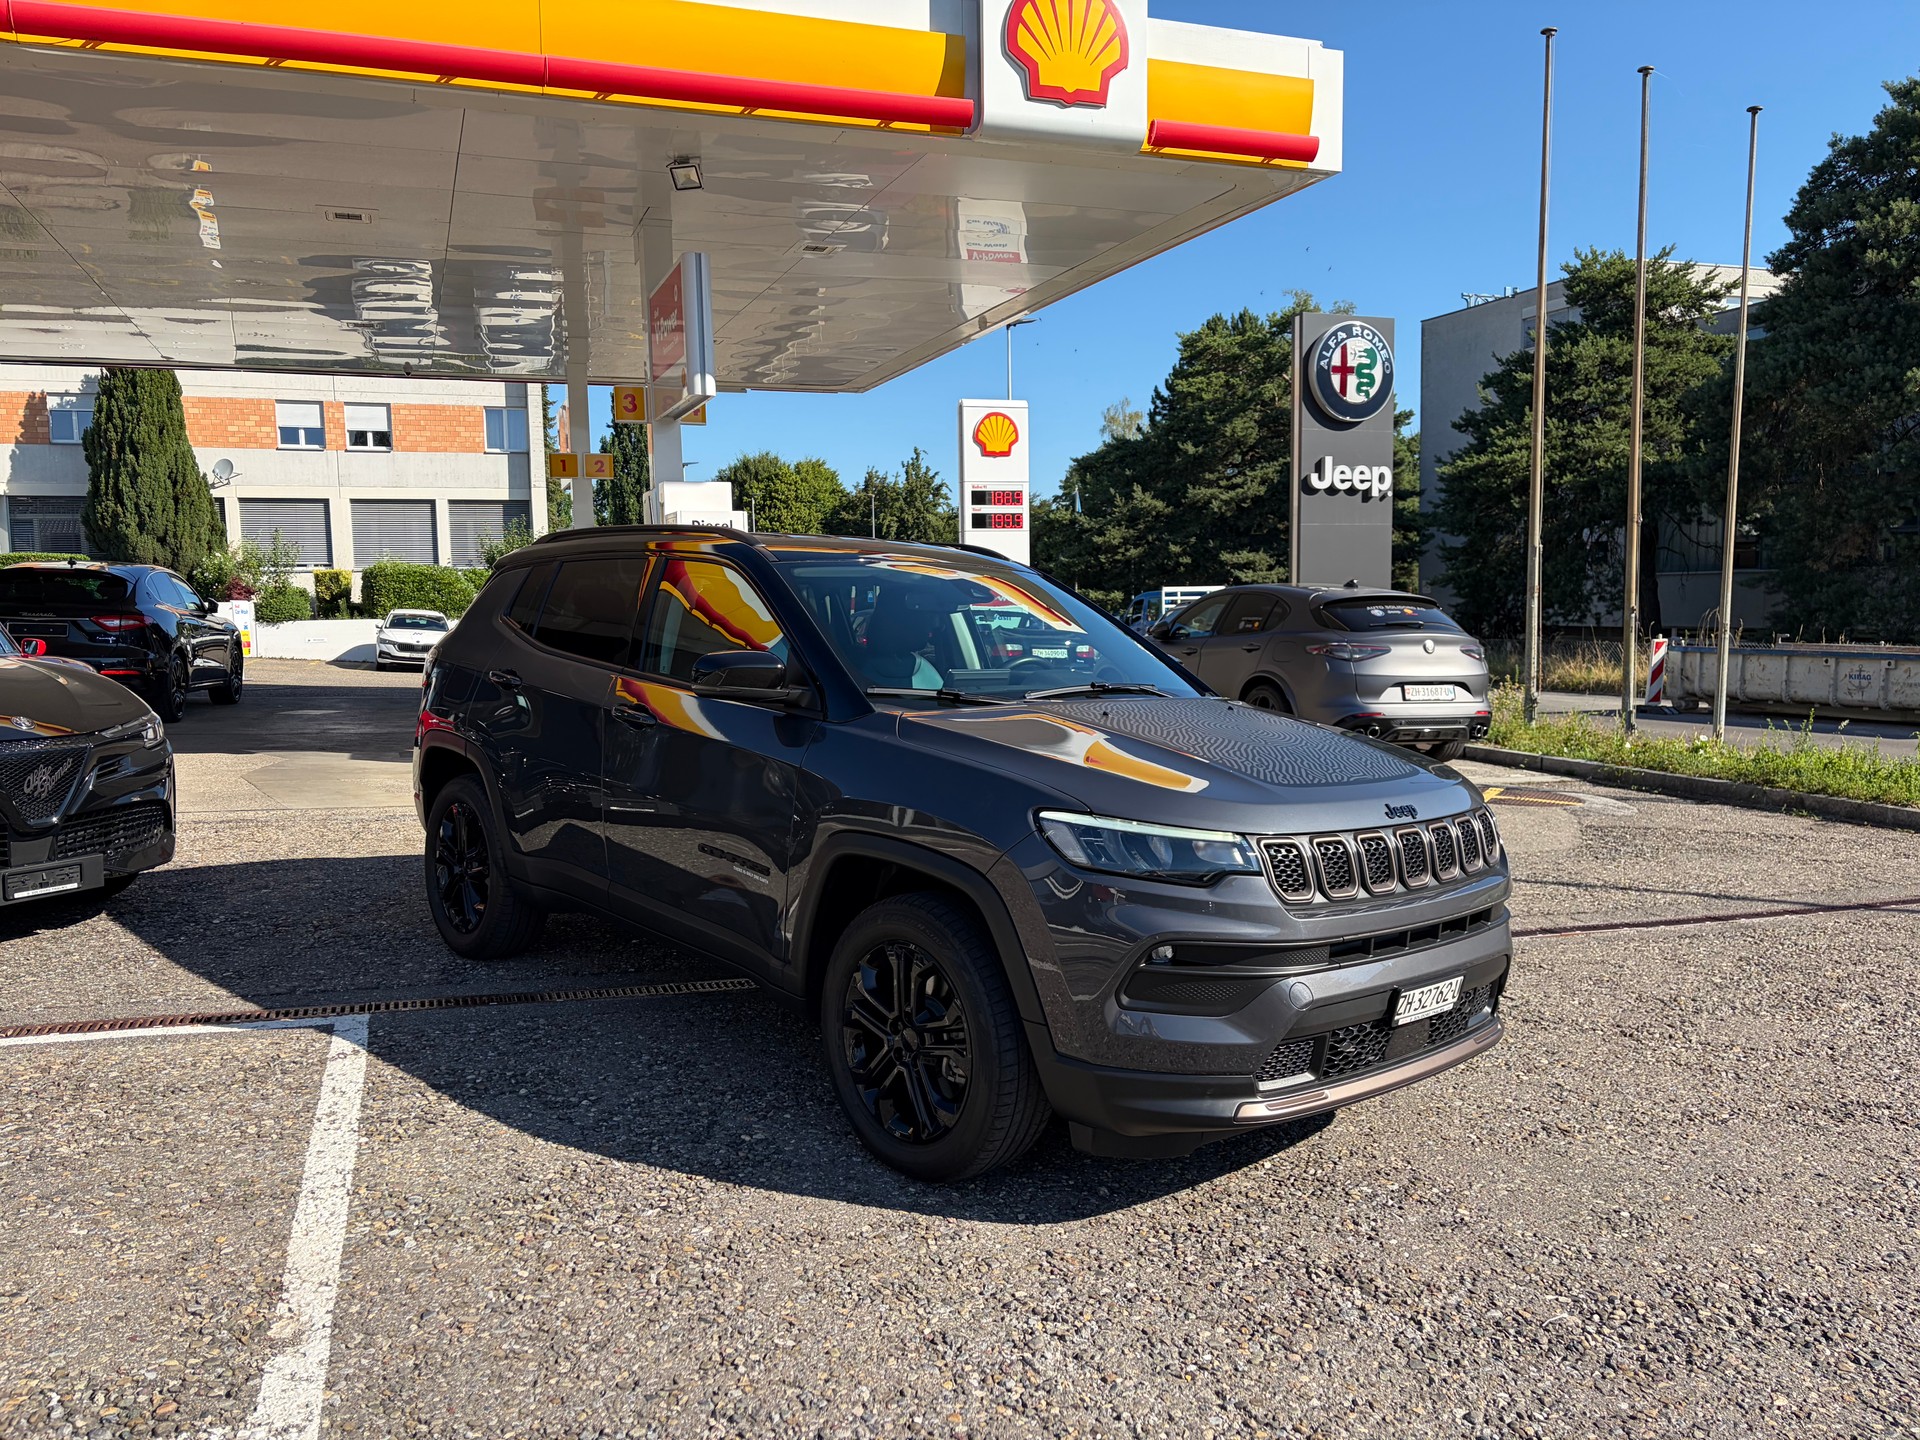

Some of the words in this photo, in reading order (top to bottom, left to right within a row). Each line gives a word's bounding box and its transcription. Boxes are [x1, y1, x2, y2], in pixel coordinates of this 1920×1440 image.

[654, 308, 679, 345] V-Power
[1319, 330, 1347, 371] ALFA
[1352, 326, 1392, 375] ROMEO
[622, 393, 638, 413] 3
[560, 459, 567, 472] 1
[594, 460, 605, 473] 2
[1310, 456, 1392, 497] Jeep
[991, 491, 1023, 506] 188.9
[991, 513, 1023, 529] 199.9
[1384, 803, 1418, 820] Jeep
